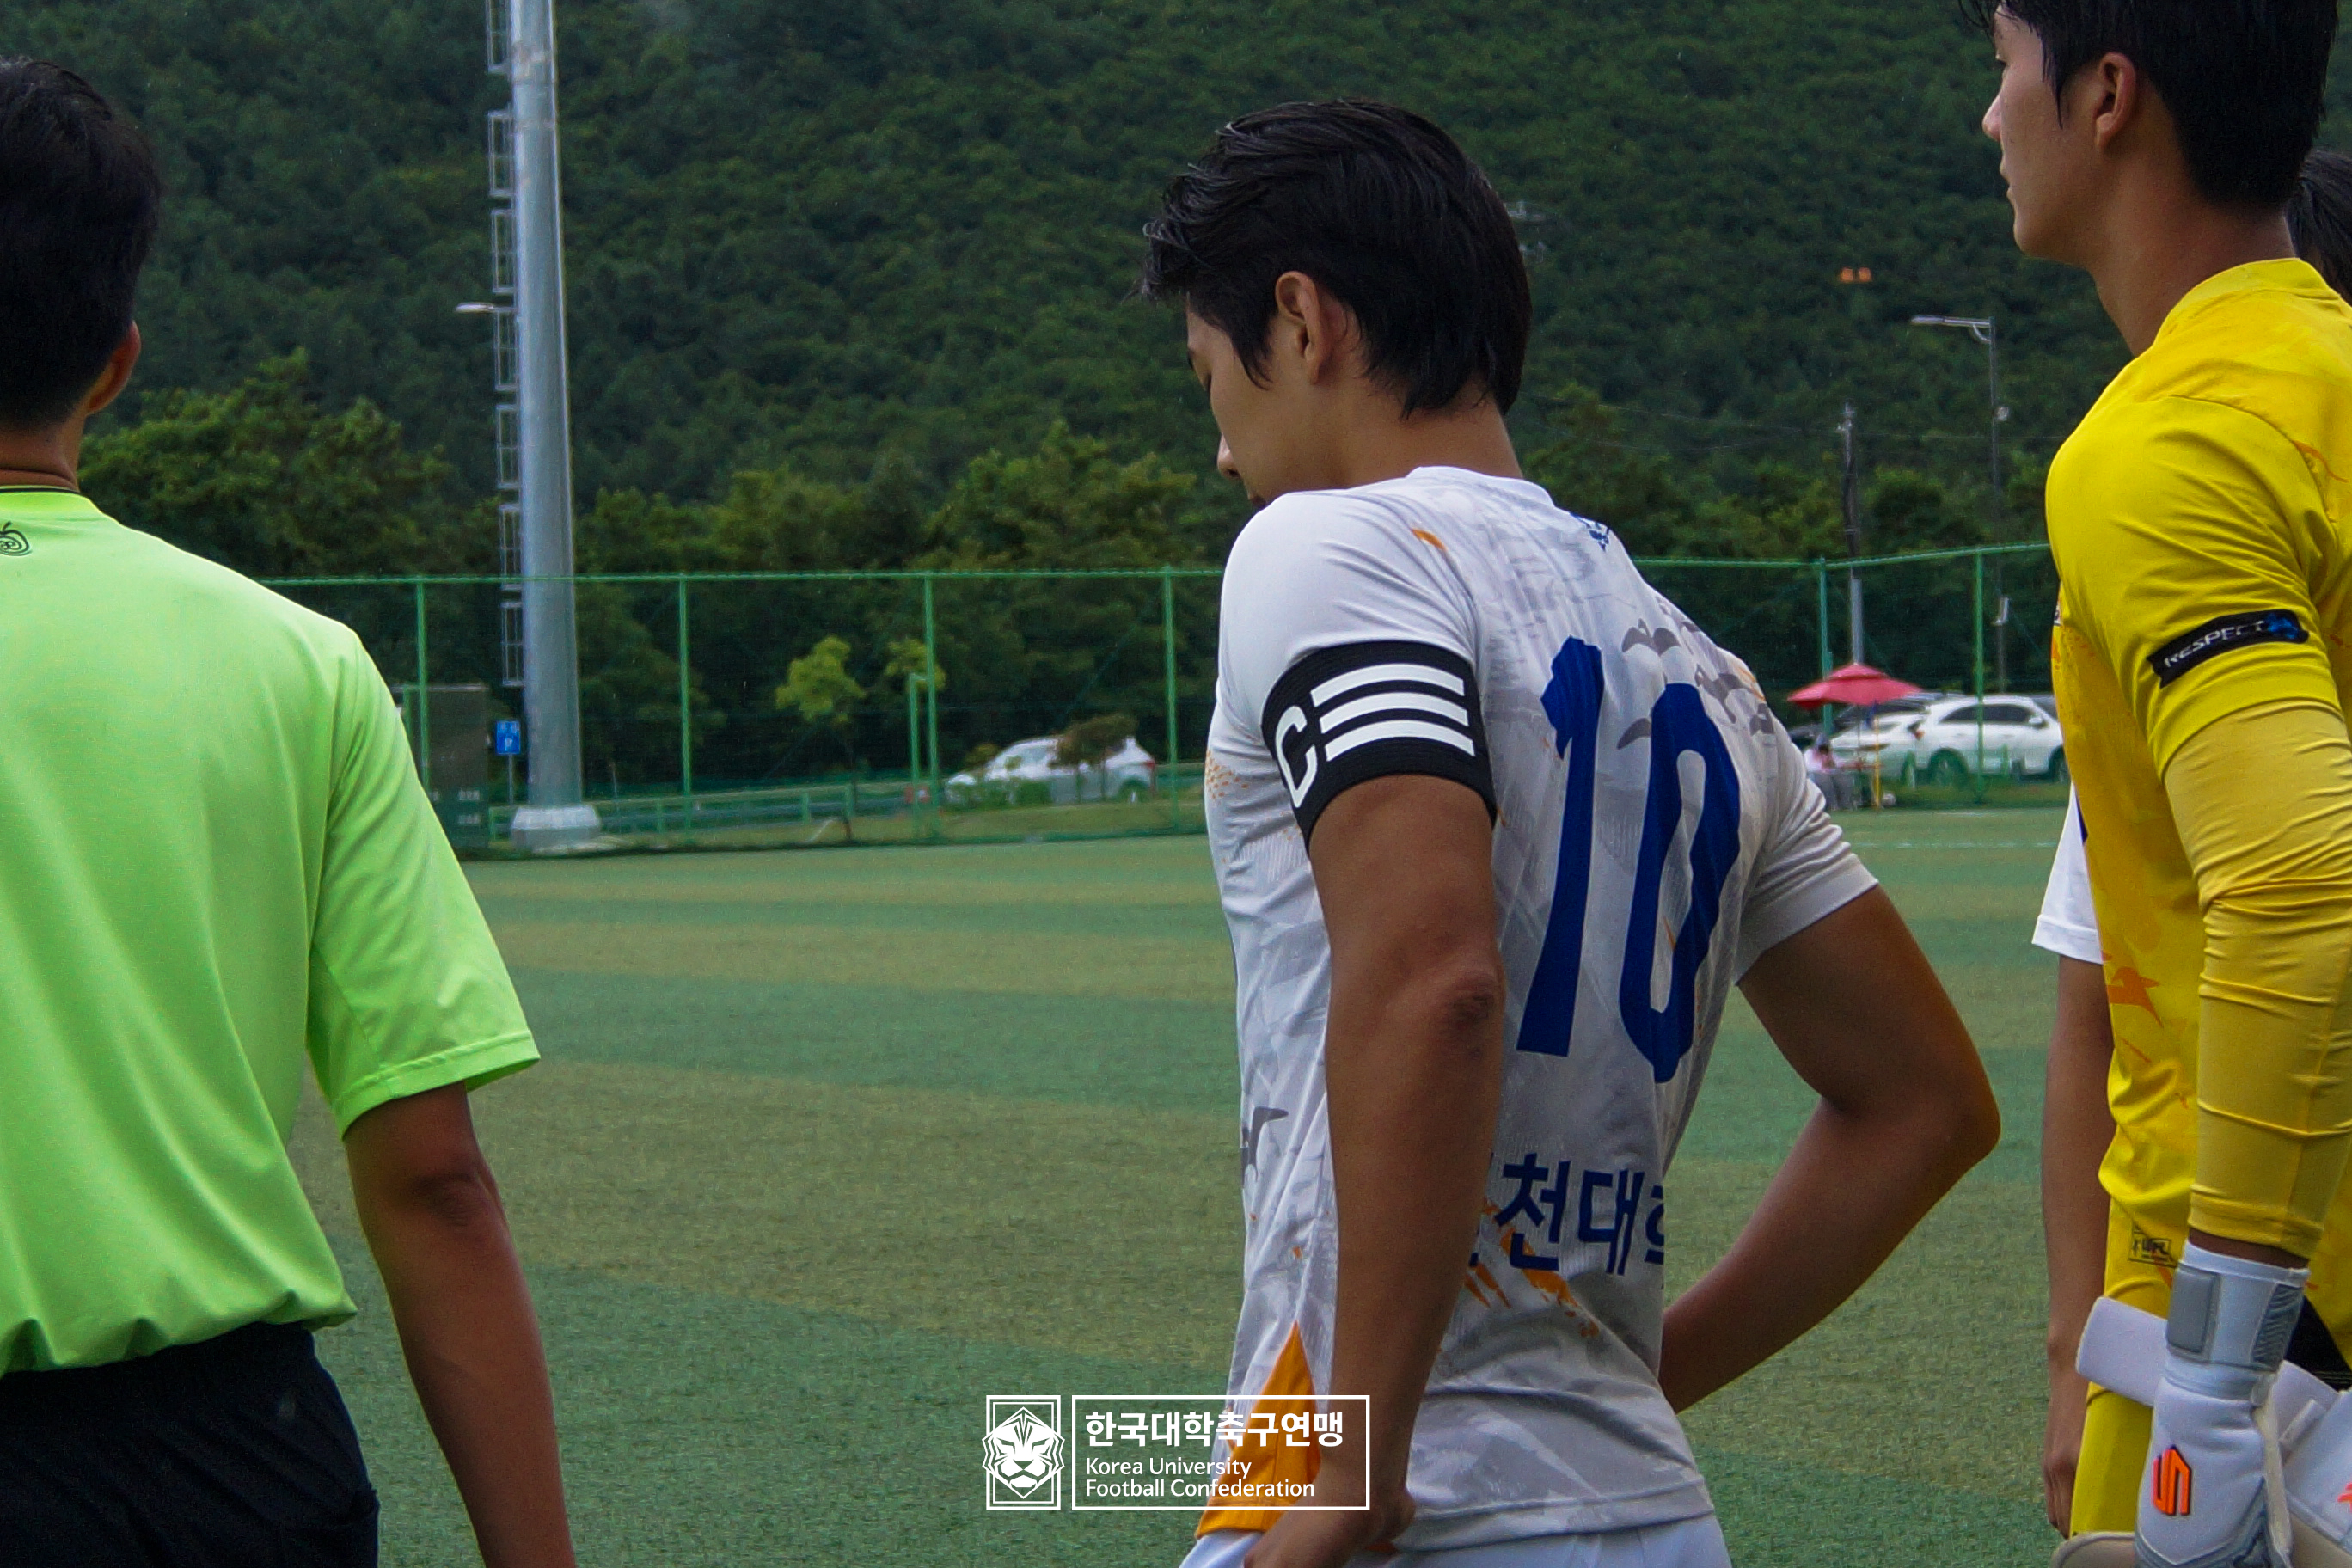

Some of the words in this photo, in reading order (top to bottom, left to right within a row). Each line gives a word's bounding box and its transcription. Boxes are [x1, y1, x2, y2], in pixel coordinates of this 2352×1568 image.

[1275, 706, 1318, 808] C
[1516, 635, 1741, 1084] 10
[1467, 1152, 1664, 1277] 천대
